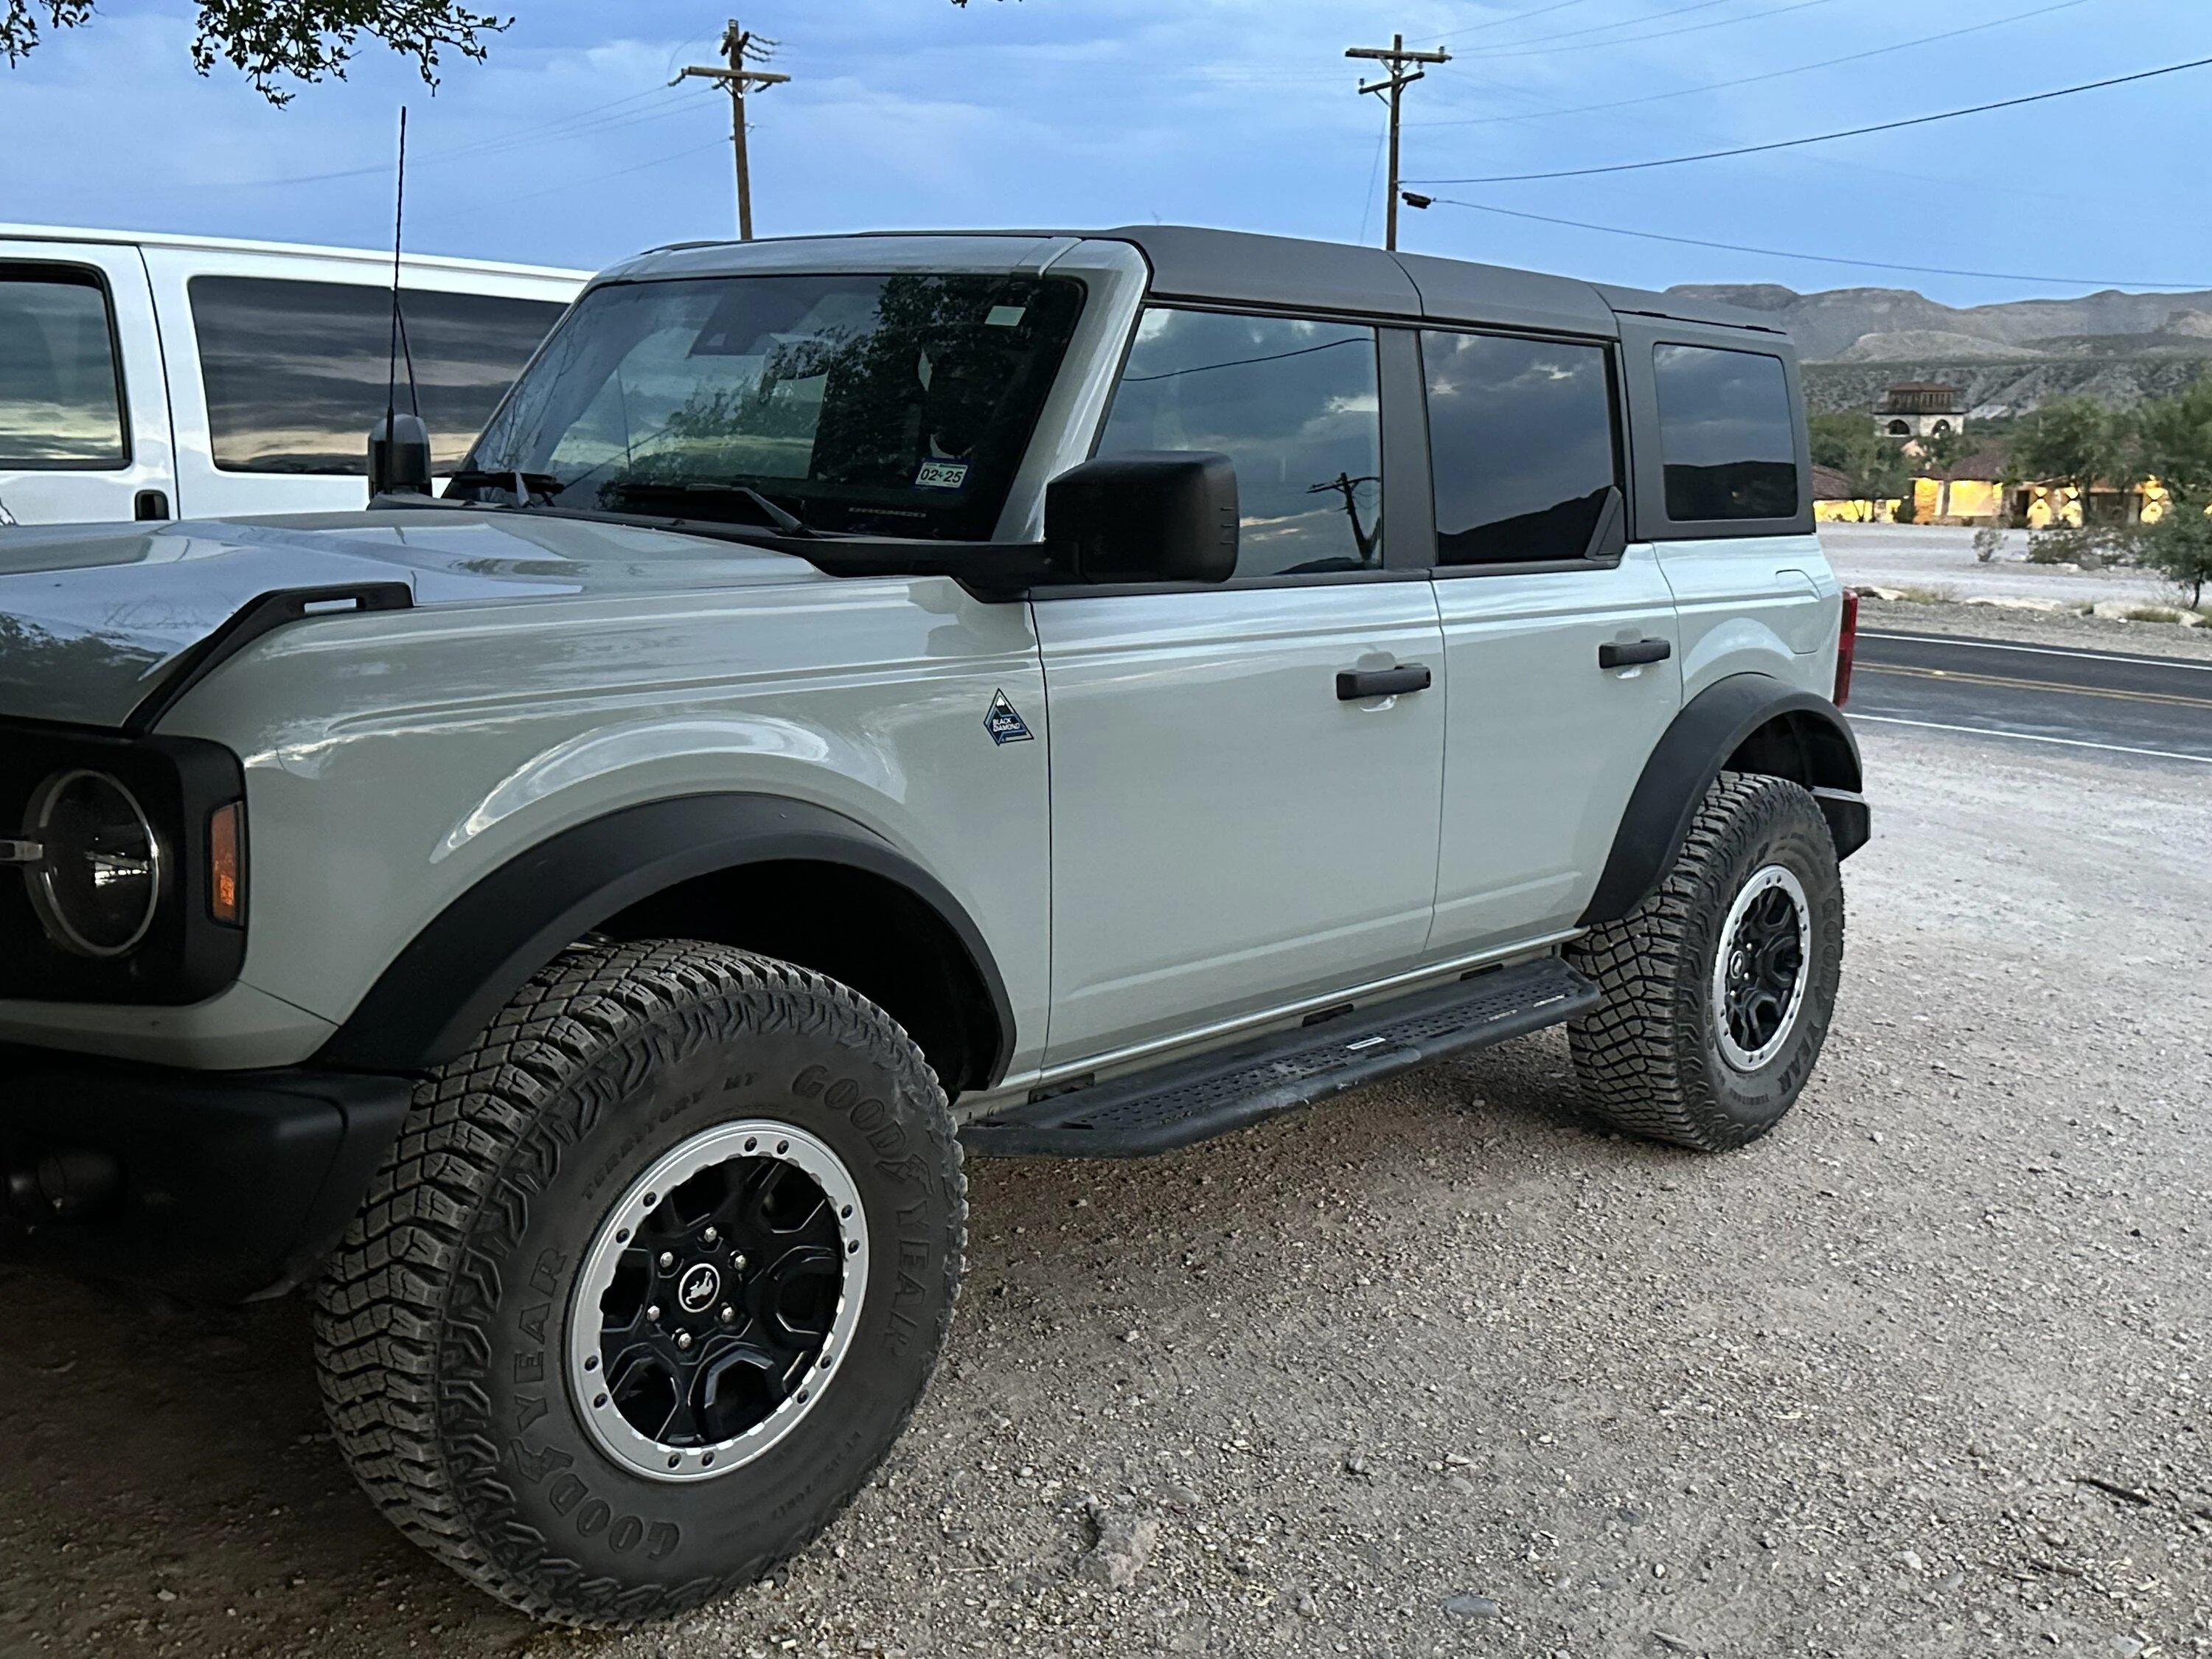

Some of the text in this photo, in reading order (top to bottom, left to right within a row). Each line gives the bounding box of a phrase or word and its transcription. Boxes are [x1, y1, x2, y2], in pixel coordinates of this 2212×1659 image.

[993, 723, 1020, 731] DIAMOND
[790, 1063, 933, 1357] GOODYEAR
[509, 1247, 681, 1562] GOODYEAR
